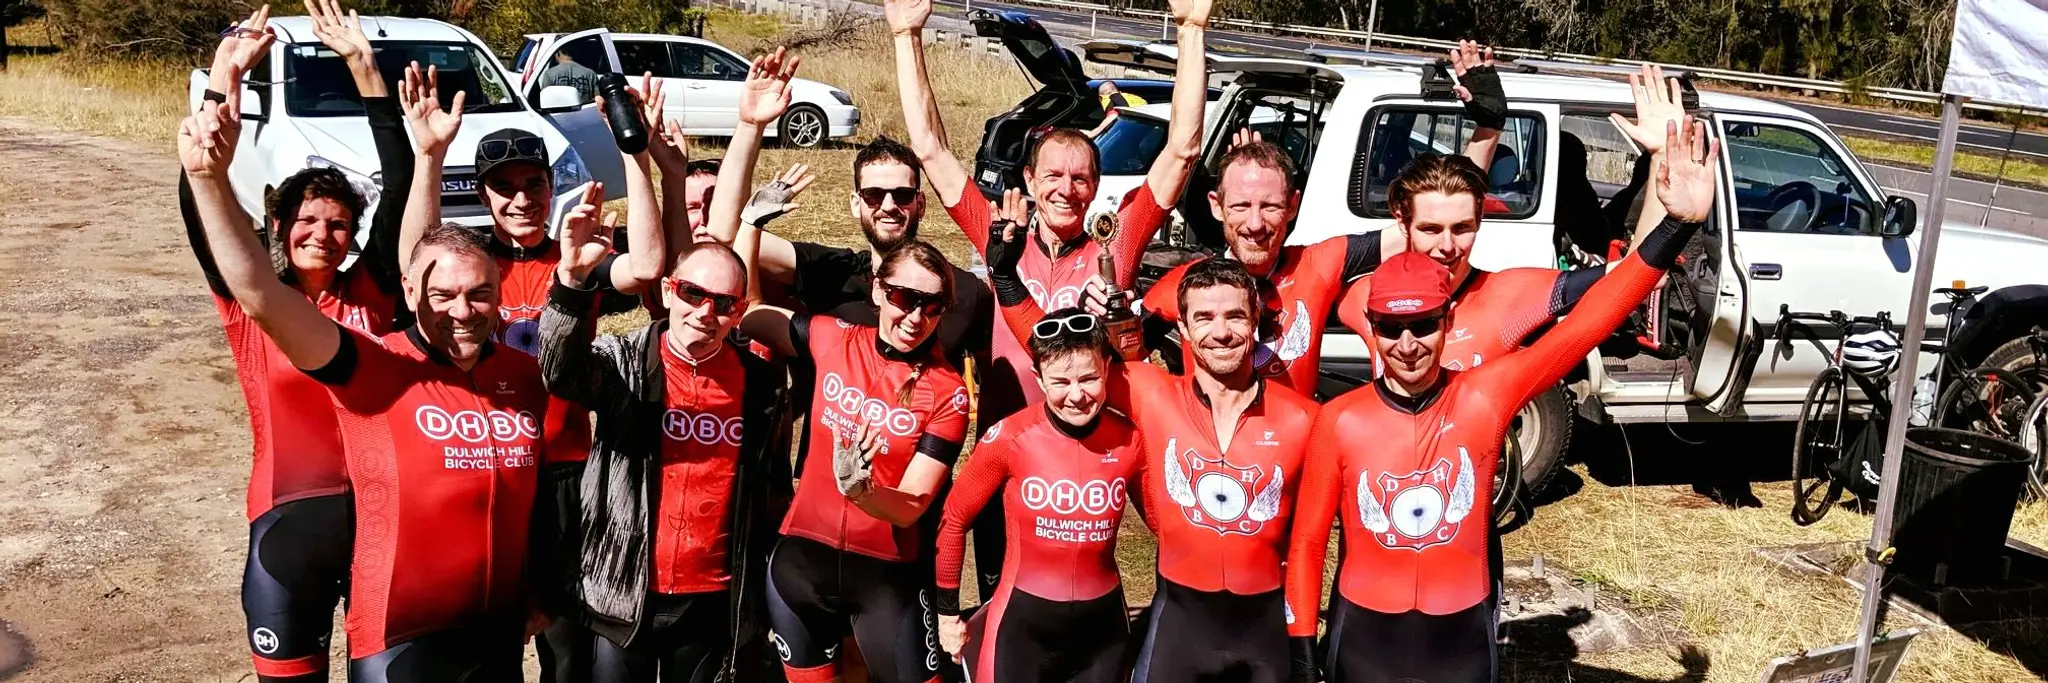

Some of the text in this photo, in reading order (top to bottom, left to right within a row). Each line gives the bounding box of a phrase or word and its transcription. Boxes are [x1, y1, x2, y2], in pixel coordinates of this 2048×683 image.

[824, 375, 913, 432] DHBC
[420, 408, 538, 438] DHBC
[444, 445, 534, 458] DULWICH HILL
[444, 456, 535, 469] BICYCLE CLUB
[1192, 457, 1255, 483] D H
[1385, 467, 1446, 491] D H
[1024, 480, 1124, 511] DHBC
[1036, 516, 1115, 530] DULWICH HILL
[1192, 509, 1251, 531] B C
[1035, 527, 1114, 542] BICYCLE CLUB
[1385, 526, 1449, 545] B C
